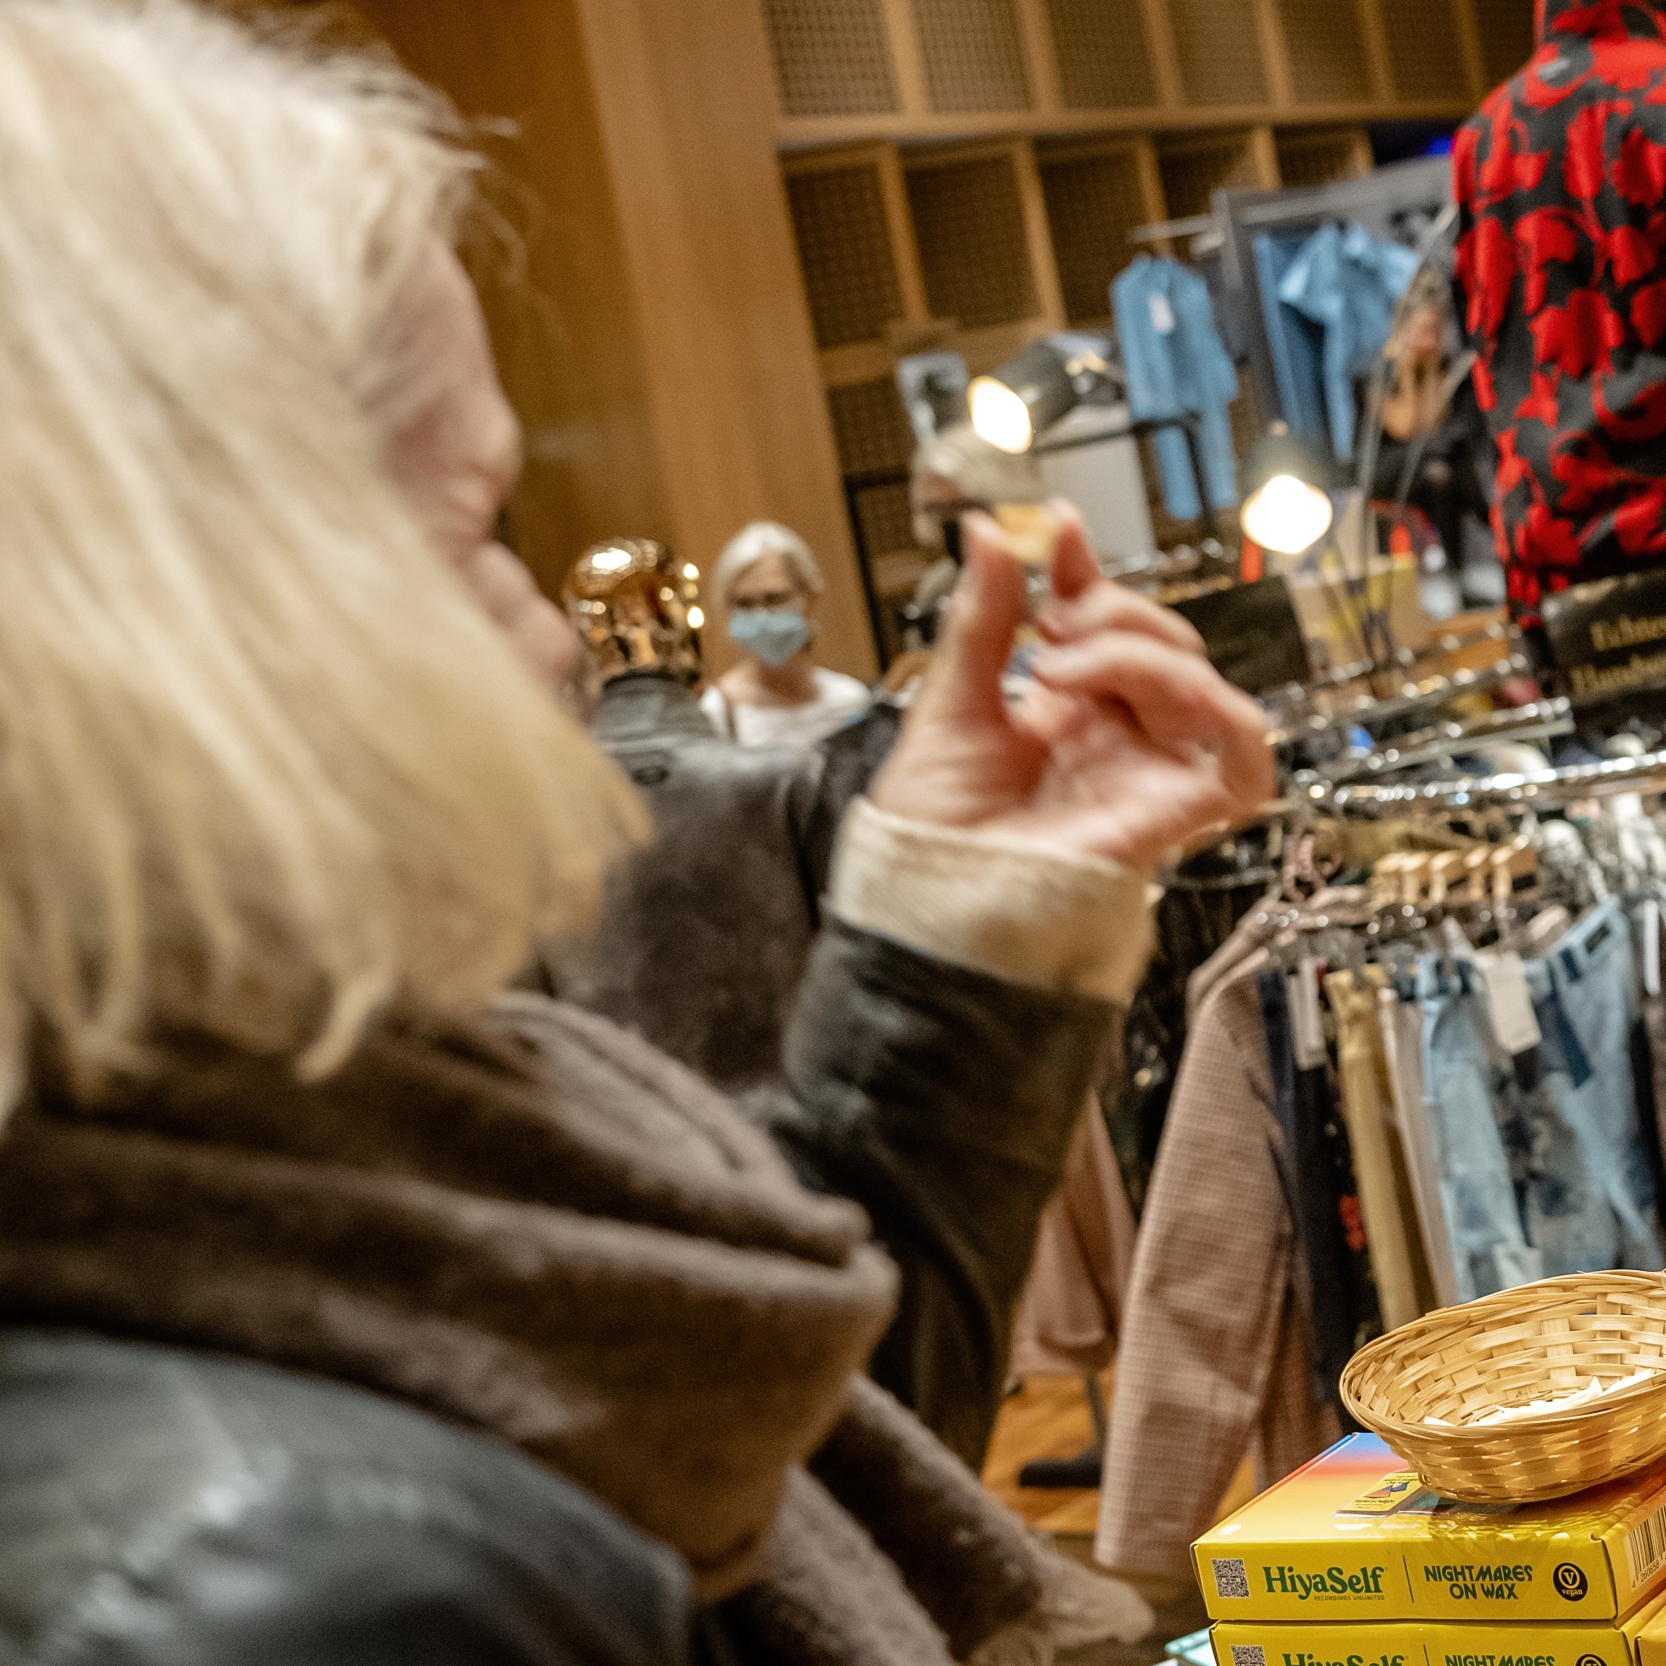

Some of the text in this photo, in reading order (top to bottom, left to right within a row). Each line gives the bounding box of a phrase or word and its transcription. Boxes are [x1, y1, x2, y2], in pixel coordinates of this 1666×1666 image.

[1425, 1564, 1533, 1582] NIGHTMARES
[1263, 1566, 1386, 1600] HiyaSelf
[1449, 1583, 1518, 1600] ON WAX
[1561, 1589, 1583, 1597] vegan
